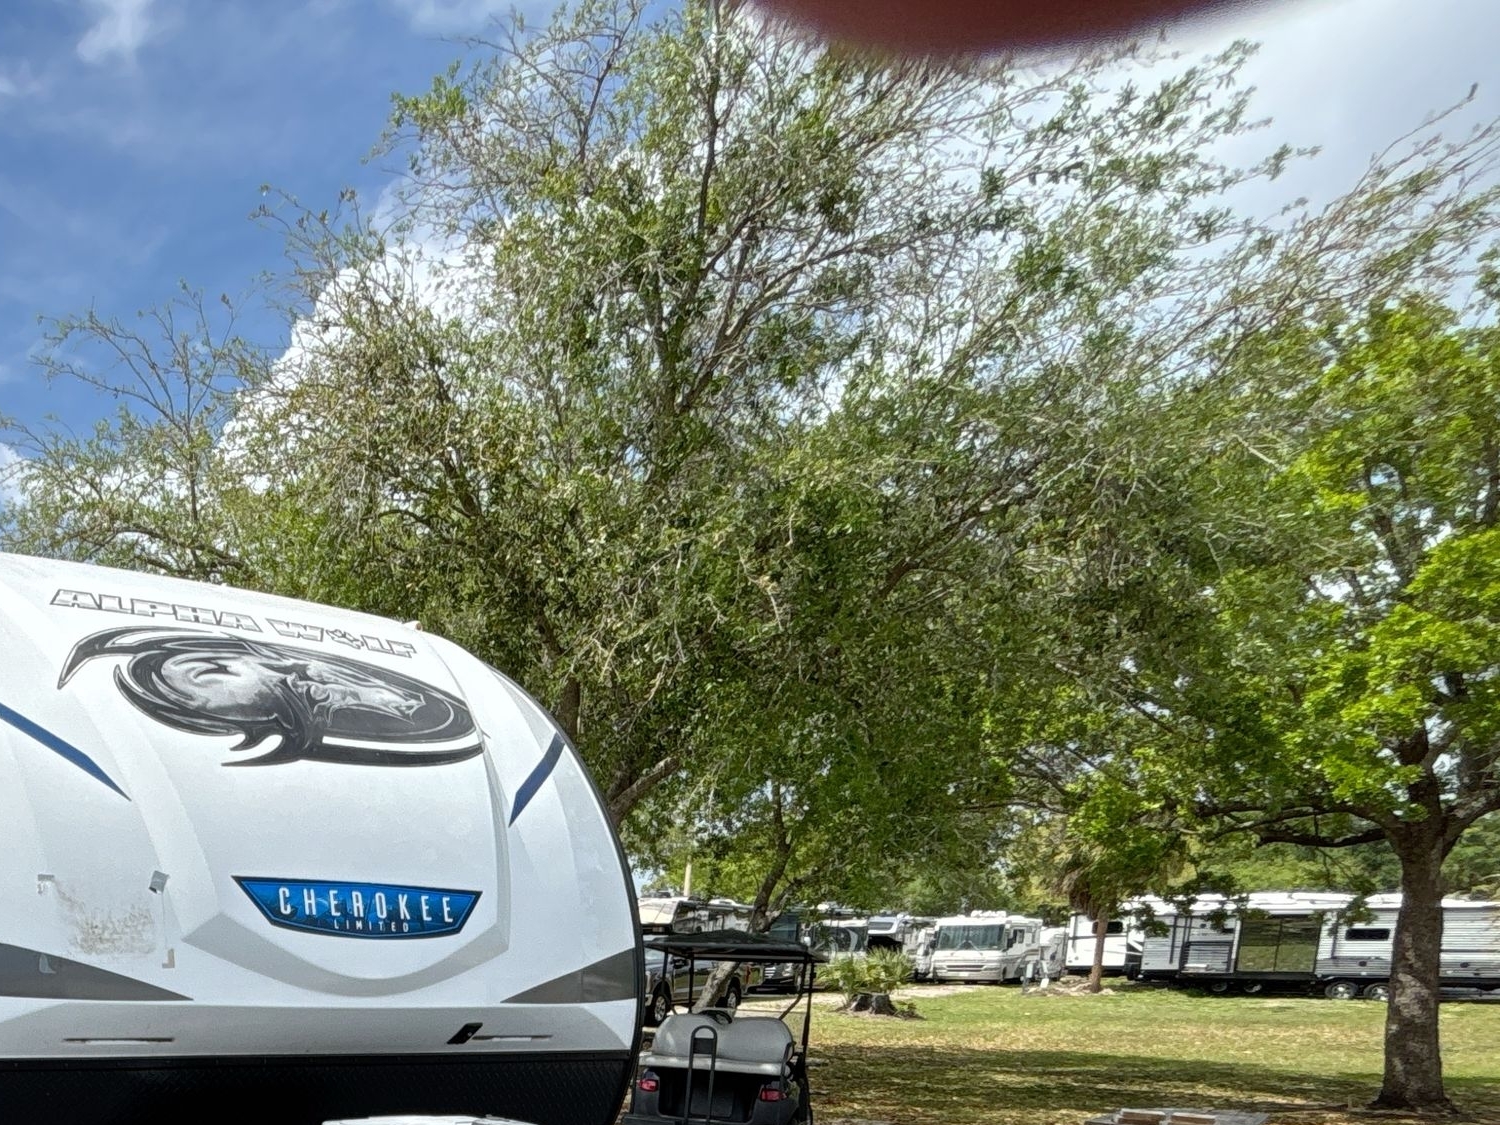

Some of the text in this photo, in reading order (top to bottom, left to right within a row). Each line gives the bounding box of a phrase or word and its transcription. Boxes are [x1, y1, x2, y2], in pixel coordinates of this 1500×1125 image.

[50, 588, 263, 632] ALPHA
[279, 886, 454, 923] CHEROKEE
[334, 919, 409, 933] LIMITED
